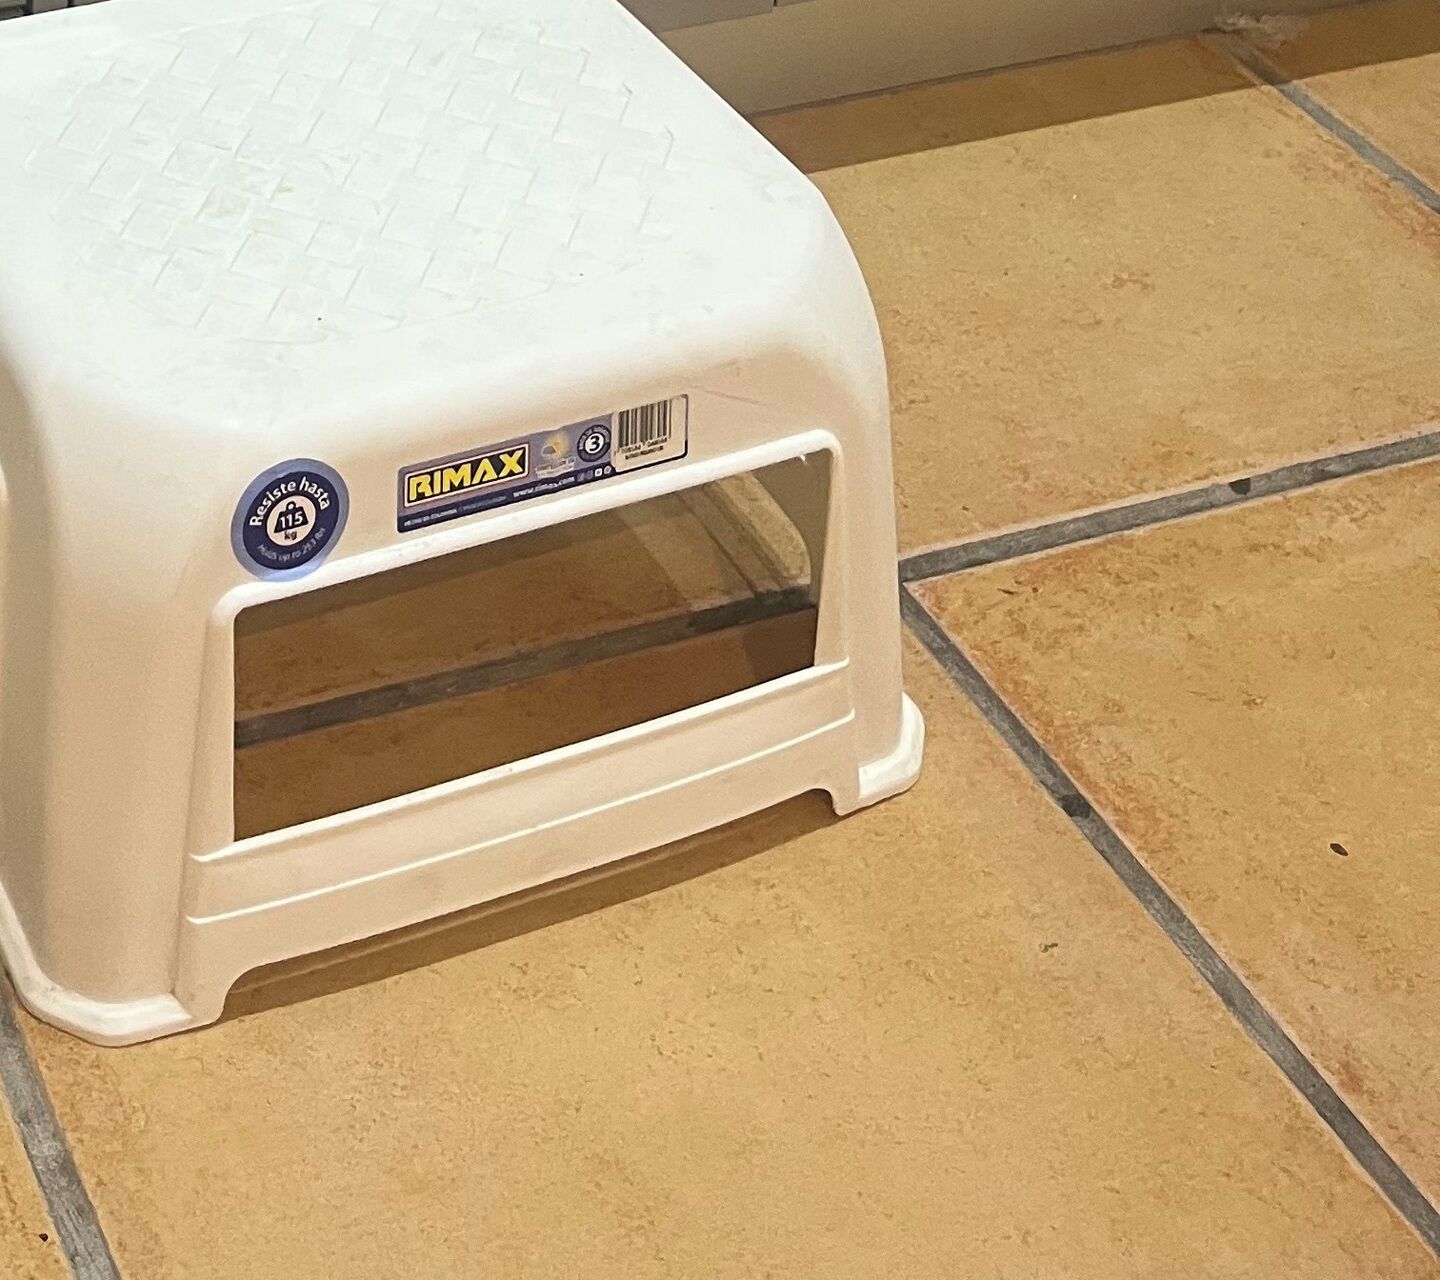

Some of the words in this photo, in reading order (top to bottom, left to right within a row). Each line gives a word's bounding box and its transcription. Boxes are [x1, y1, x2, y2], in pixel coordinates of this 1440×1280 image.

[589, 435, 600, 452] 3
[409, 449, 525, 501] RIMAX
[249, 481, 297, 526] Resiste
[299, 476, 330, 510] hasta
[280, 511, 303, 529] 115
[284, 530, 298, 541] kg
